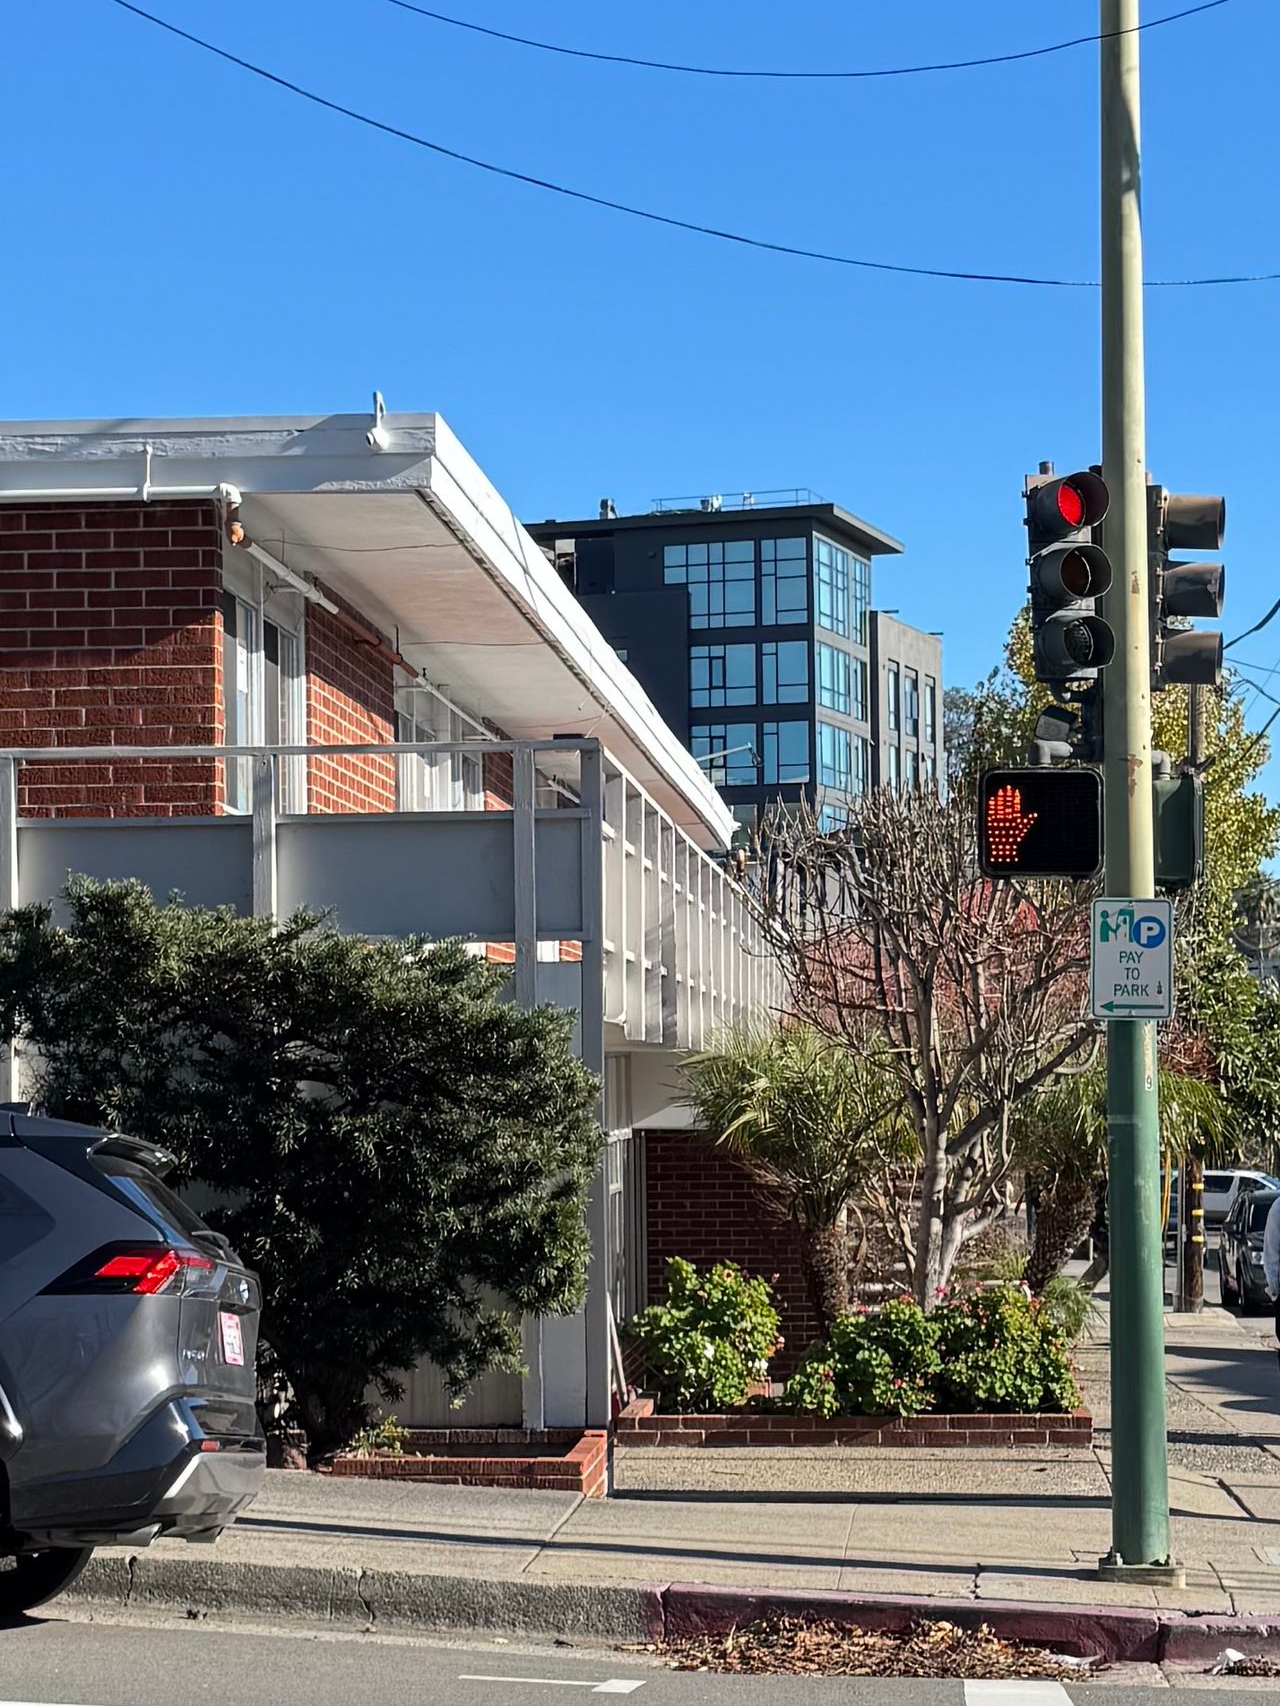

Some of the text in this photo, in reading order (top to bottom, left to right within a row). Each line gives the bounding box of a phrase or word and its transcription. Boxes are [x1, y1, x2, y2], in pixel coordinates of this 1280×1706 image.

[1140, 921, 1160, 944] P
[1119, 951, 1144, 964] PAY
[1125, 967, 1140, 980] TO
[1113, 983, 1150, 997] PARK
